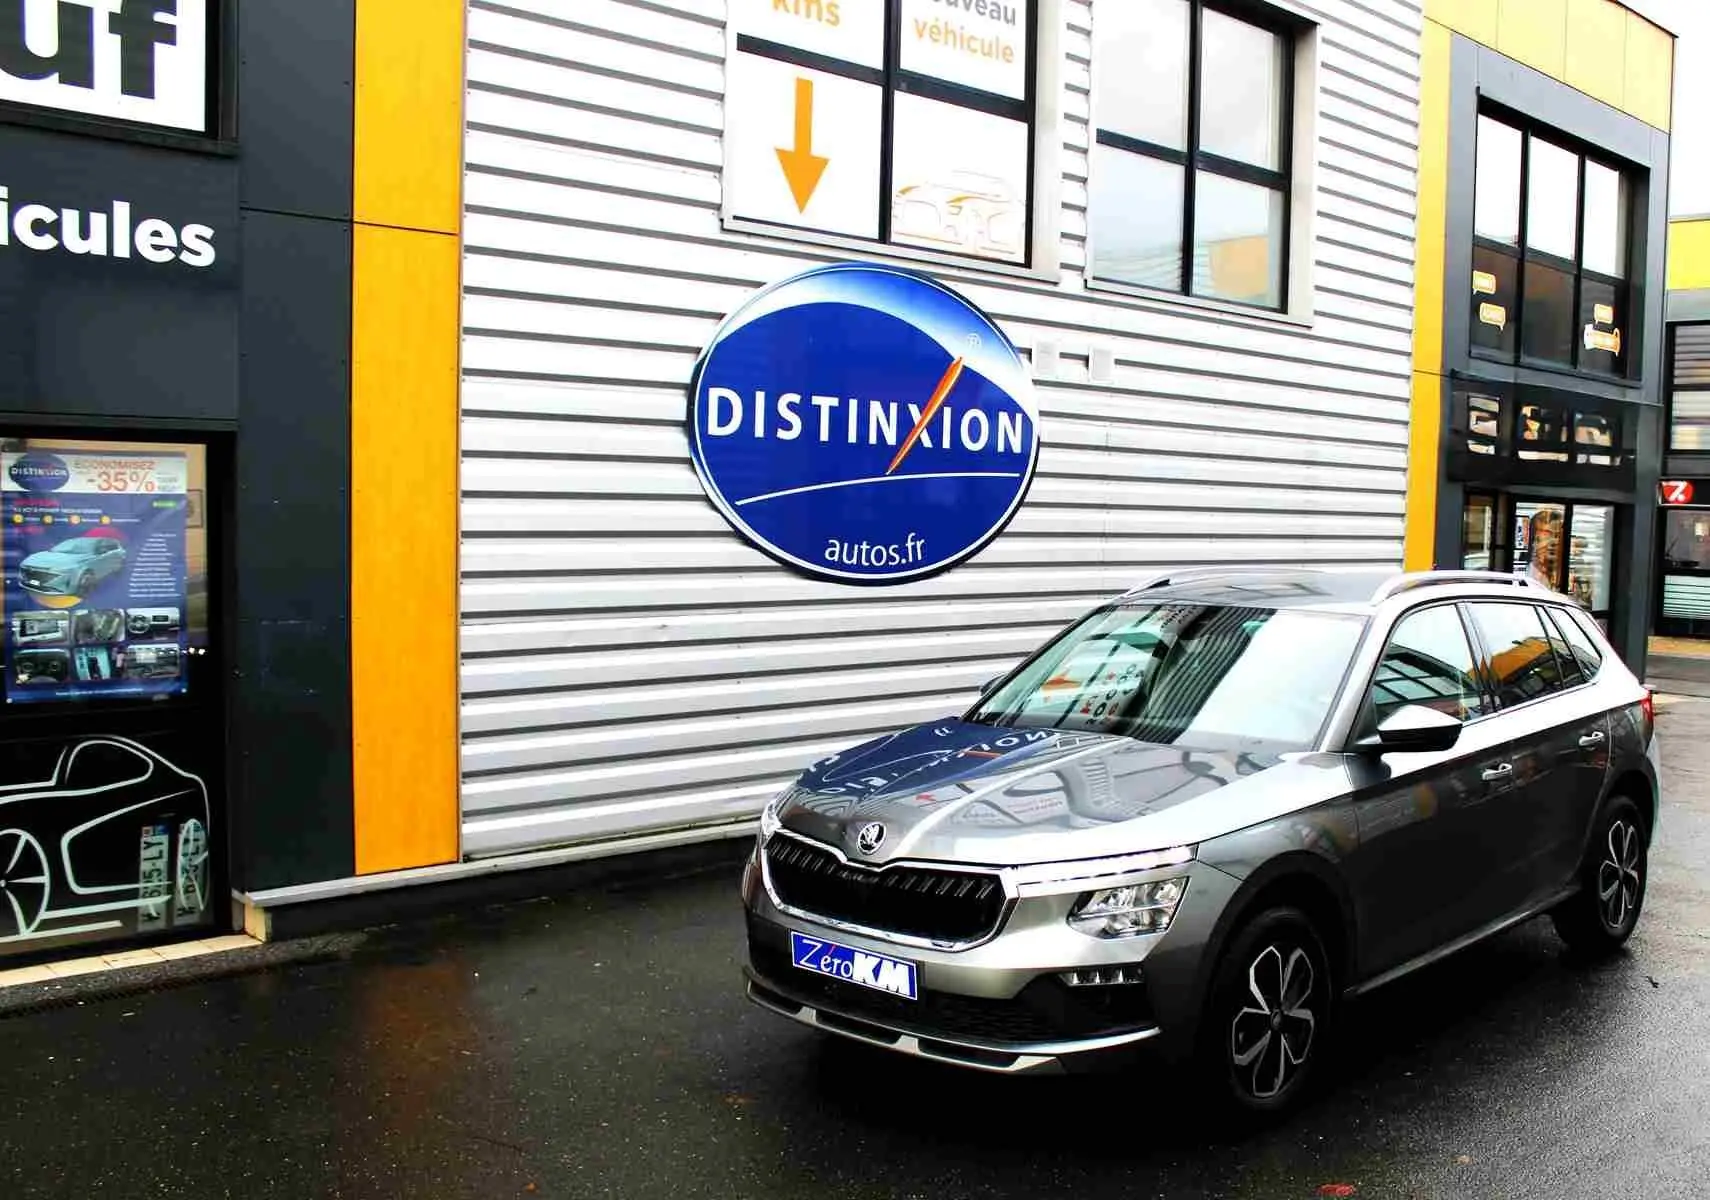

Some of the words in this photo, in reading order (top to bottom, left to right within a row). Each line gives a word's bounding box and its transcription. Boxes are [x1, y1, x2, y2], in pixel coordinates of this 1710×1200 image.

[932, 0, 1016, 26] veau
[914, 17, 1014, 63] véhicule
[707, 387, 1025, 455] DISTINXION
[825, 533, 925, 567] autos.fr
